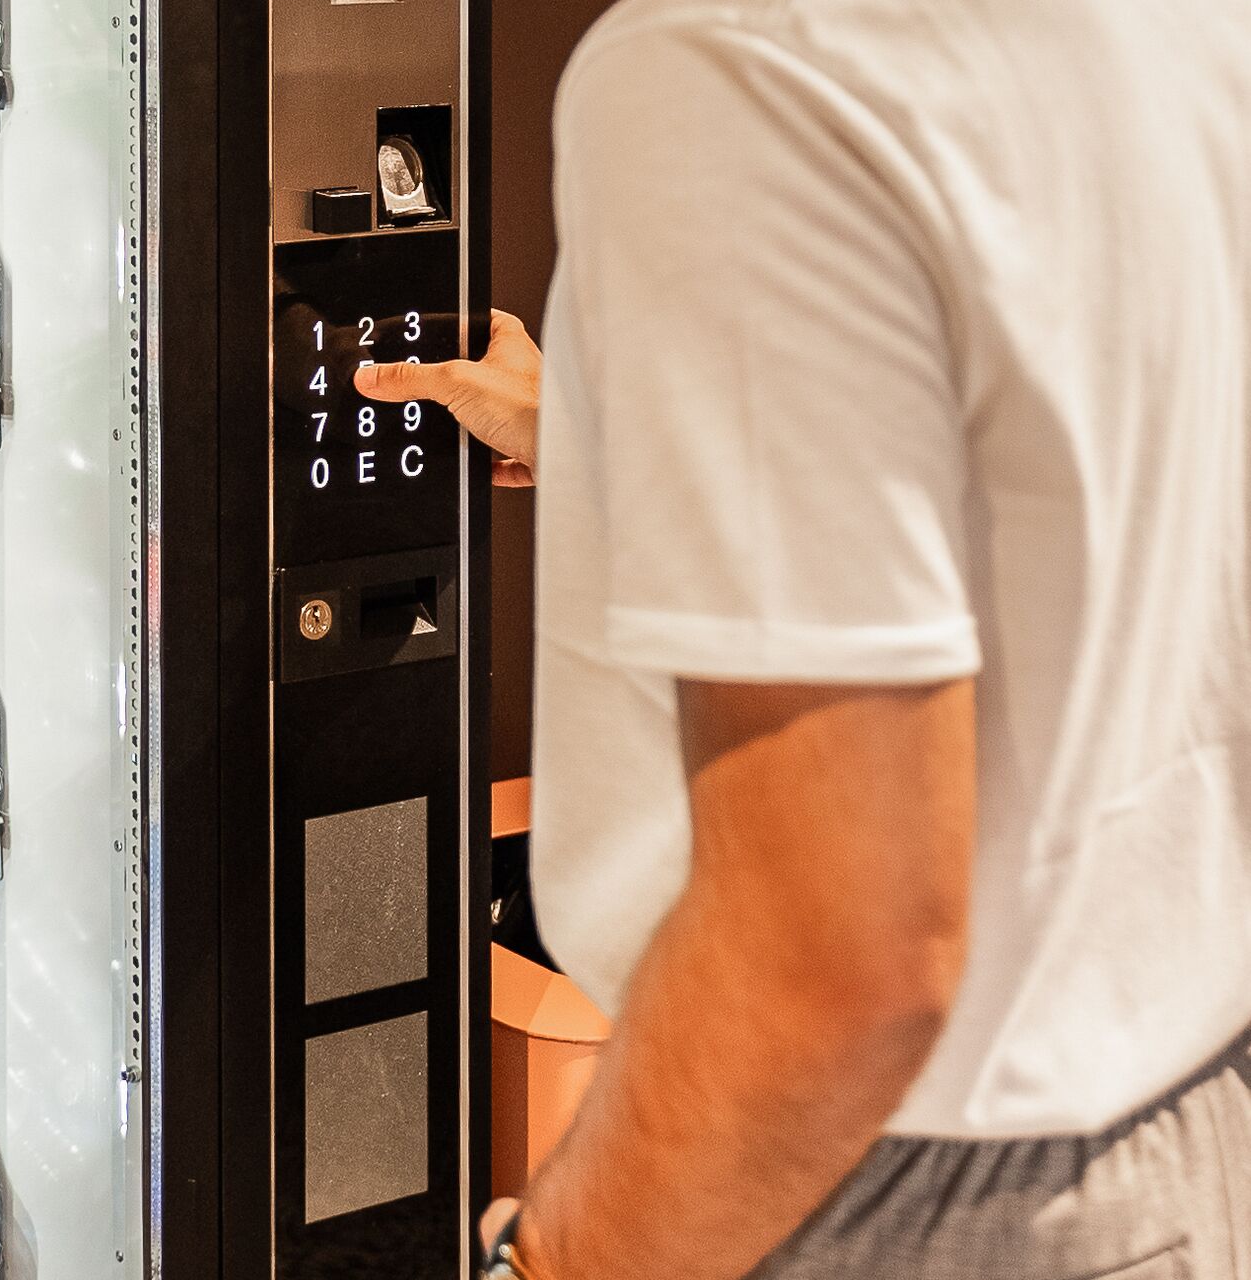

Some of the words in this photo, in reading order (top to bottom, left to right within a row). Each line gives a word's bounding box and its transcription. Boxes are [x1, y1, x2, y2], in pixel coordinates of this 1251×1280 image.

[313, 321, 324, 352] 1
[358, 316, 375, 346] 2
[403, 311, 421, 342] 3
[309, 365, 328, 396] 4
[311, 412, 328, 442] 7
[358, 406, 376, 437] 8
[403, 401, 422, 432] 9
[310, 457, 330, 489] 0
[358, 451, 376, 483] E
[400, 444, 424, 477] C
